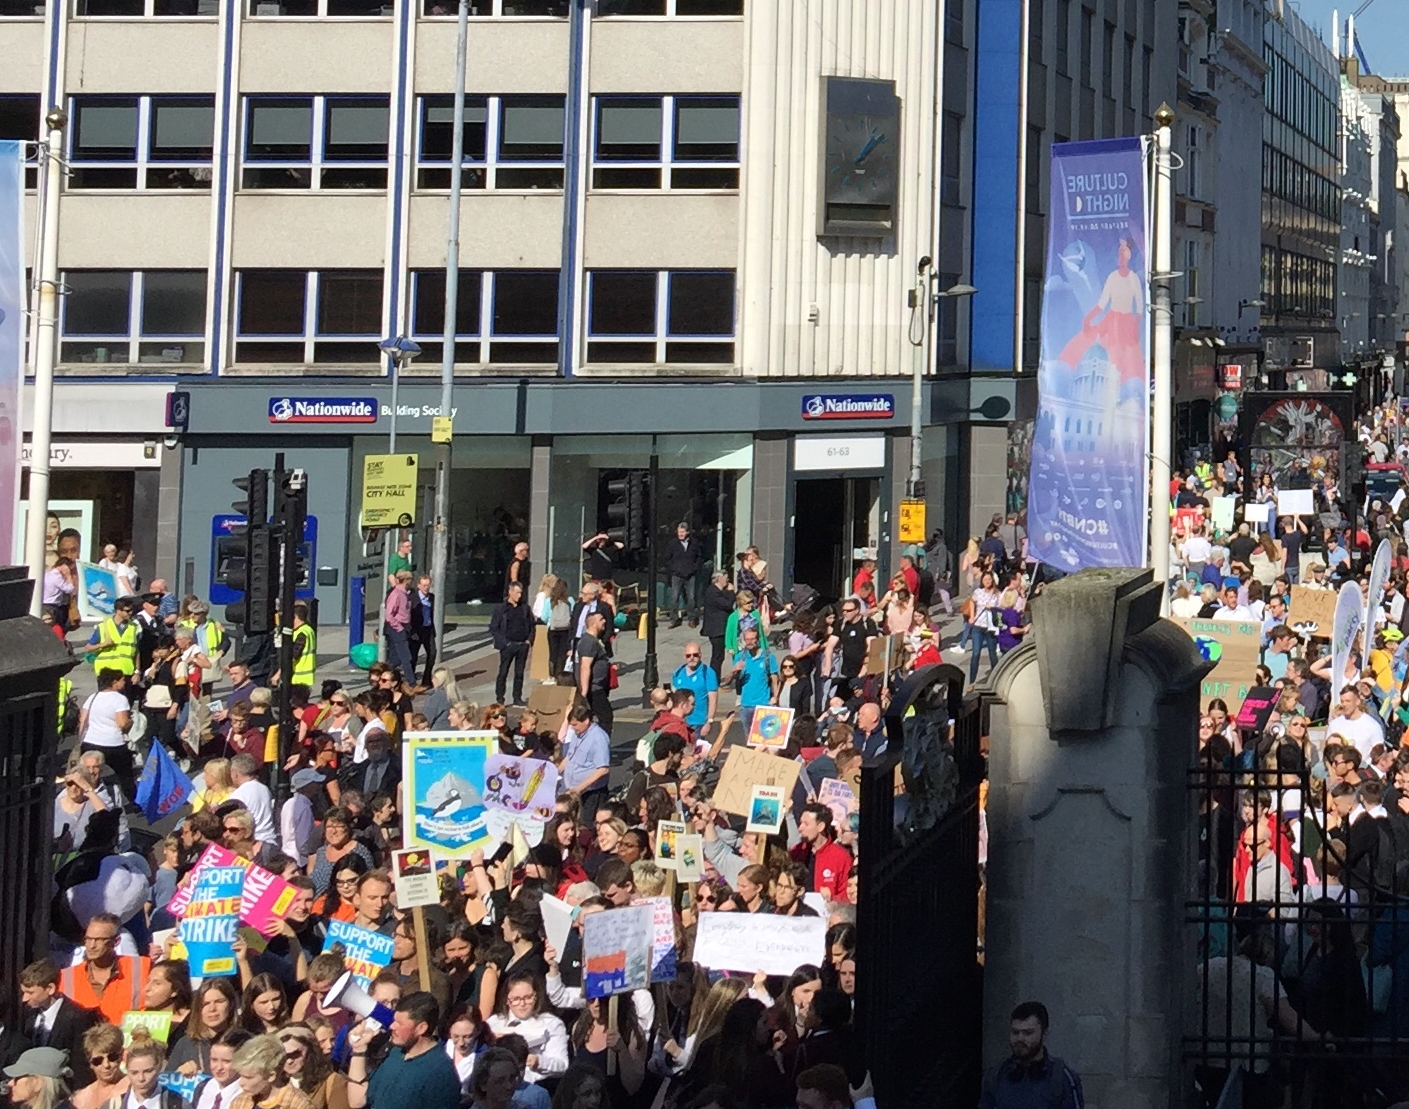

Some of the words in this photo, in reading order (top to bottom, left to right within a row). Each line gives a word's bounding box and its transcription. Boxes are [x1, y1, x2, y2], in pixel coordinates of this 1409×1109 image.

[295, 401, 373, 417] Nationwide
[381, 405, 420, 418] Bulding
[825, 397, 891, 412] Nationwide
[827, 446, 850, 457] 61-63
[366, 490, 385, 498] CITY
[1202, 683, 1231, 698] NET
[733, 751, 790, 780] MAKE
[180, 918, 238, 942] STRIKE
[329, 922, 394, 954] SUPPORT
[345, 943, 373, 960] THE
